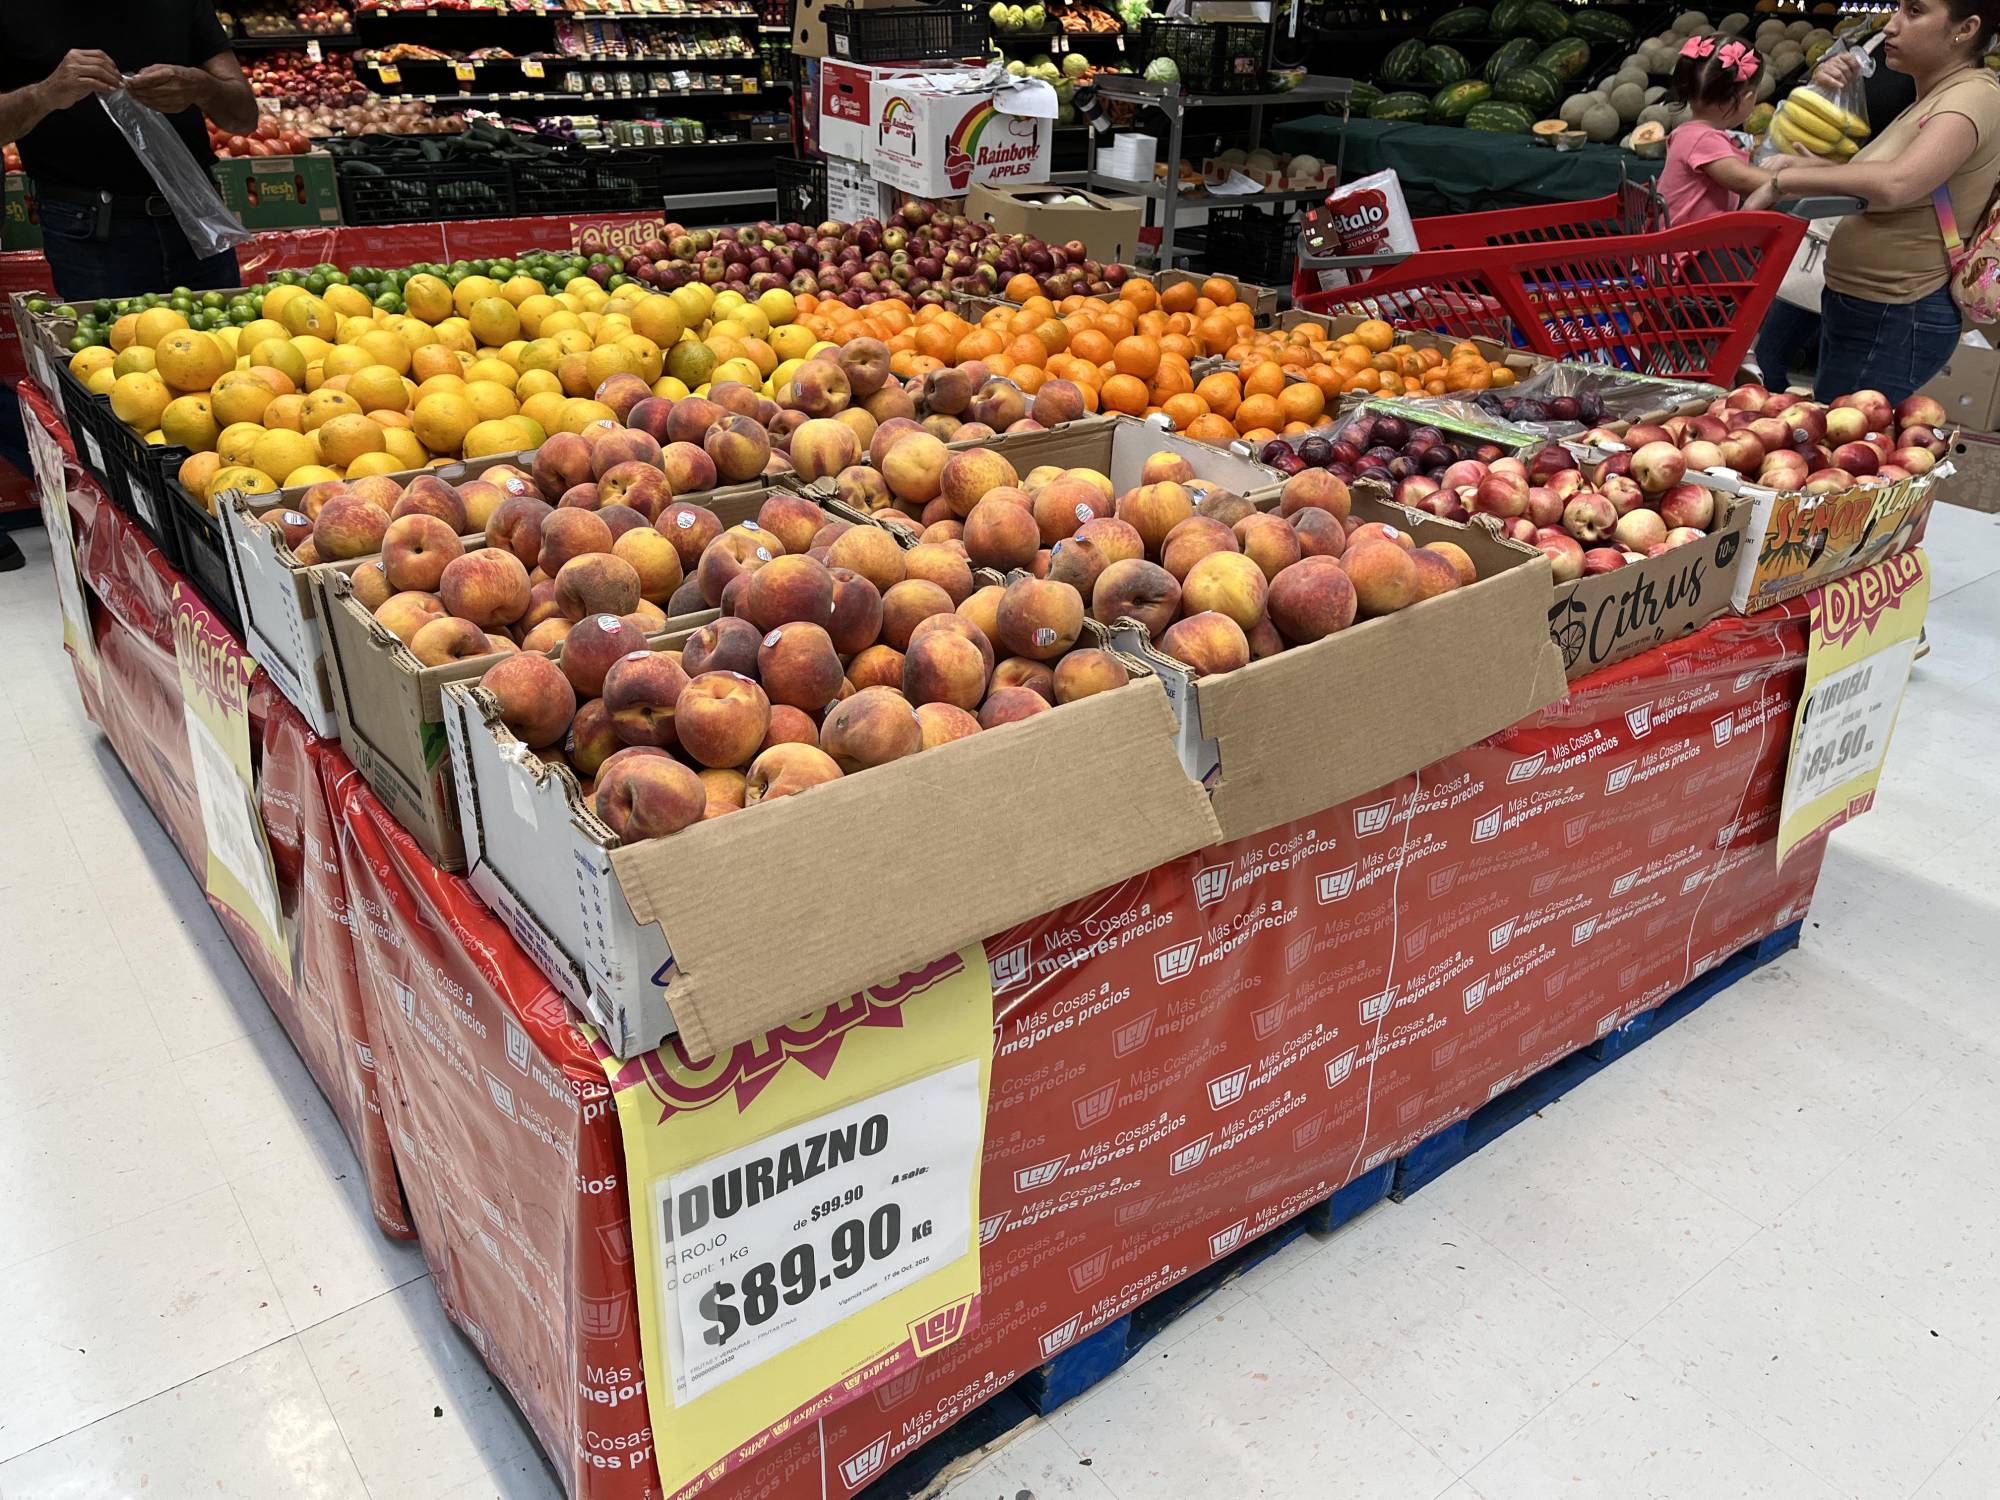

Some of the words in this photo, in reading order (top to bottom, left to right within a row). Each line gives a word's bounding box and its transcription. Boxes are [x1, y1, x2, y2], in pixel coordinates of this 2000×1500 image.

[977, 141, 1040, 166] Rainbow
[989, 164, 1031, 179] APPLES
[261, 182, 294, 196] Fresh
[1589, 557, 1707, 661] Citrus
[1652, 704, 1689, 727] mejores
[1690, 689, 1719, 708] precios
[1658, 697, 1675, 710] Más
[1678, 686, 1703, 702] Cosas
[1704, 683, 1711, 691] a
[1541, 753, 1587, 776] mejores
[1588, 737, 1618, 763] precios
[1552, 740, 1569, 760] Más
[1569, 731, 1594, 750] Cosas
[1594, 729, 1601, 738] a
[1392, 798, 1448, 826] mejores
[1451, 780, 1484, 808] precios
[1402, 790, 1430, 806] Más
[1433, 778, 1462, 798] Cosas
[1463, 772, 1470, 784] a
[1508, 798, 1528, 814] Más
[1530, 787, 1562, 804] Cosas
[1564, 786, 1574, 794] a
[1503, 804, 1543, 832] mejores
[1544, 792, 1585, 811] precios
[1232, 860, 1290, 892] mejores
[1292, 839, 1337, 864] precios
[1240, 848, 1263, 870] Más
[1268, 834, 1303, 858] Cosas
[1306, 829, 1316, 840] a
[1356, 858, 1403, 890] mejores
[1406, 840, 1448, 868] precios
[1362, 852, 1384, 870] Más
[1388, 836, 1421, 858] Cosas
[1424, 832, 1432, 843] a
[1037, 937, 1118, 975] mejores
[1121, 910, 1174, 947] precios
[1044, 929, 1081, 951] Más
[1084, 909, 1138, 936] Cosas
[1141, 903, 1150, 917] a
[1199, 930, 1250, 967] mejores
[1251, 906, 1298, 936] precios
[1208, 924, 1230, 946] Más
[1233, 901, 1266, 930] Cosas
[1271, 900, 1282, 910] a
[1395, 980, 1442, 1009] mejores
[1442, 955, 1474, 987] precios
[1406, 974, 1426, 992] Más
[1428, 958, 1454, 982] Cosas
[1456, 950, 1462, 962] a
[1000, 1015, 1074, 1056] mejores
[1079, 986, 1130, 1023] precios
[1016, 1012, 1048, 1035] Más
[1052, 989, 1096, 1018] Cosas
[1100, 981, 1110, 995] a
[1063, 1144, 1134, 1177] mejores
[1139, 1114, 1186, 1151] precios
[1080, 1140, 1110, 1160] Más
[1114, 1118, 1156, 1145] Cosas
[1159, 1112, 1168, 1123] a
[901, 1166, 929, 1183] solo:
[793, 1218, 808, 1230] de
[810, 1185, 864, 1222] $99.90
[681, 1233, 727, 1263] ROJO
[730, 1246, 749, 1263] KG
[699, 1203, 900, 1346] $89.90
[912, 1220, 933, 1242] KG
[1091, 1297, 1115, 1316] Más
[1120, 1273, 1158, 1298] Cosas
[1160, 1264, 1170, 1274] a
[1080, 1294, 1138, 1334] mejores
[1141, 1266, 1188, 1300] precios
[587, 1365, 632, 1384] Más
[890, 1407, 958, 1457] mejores
[962, 1370, 1016, 1410] precios
[901, 1411, 932, 1436] Más
[937, 1380, 980, 1412] Cosas
[984, 1370, 994, 1382] a
[586, 1427, 652, 1451] Cosas
